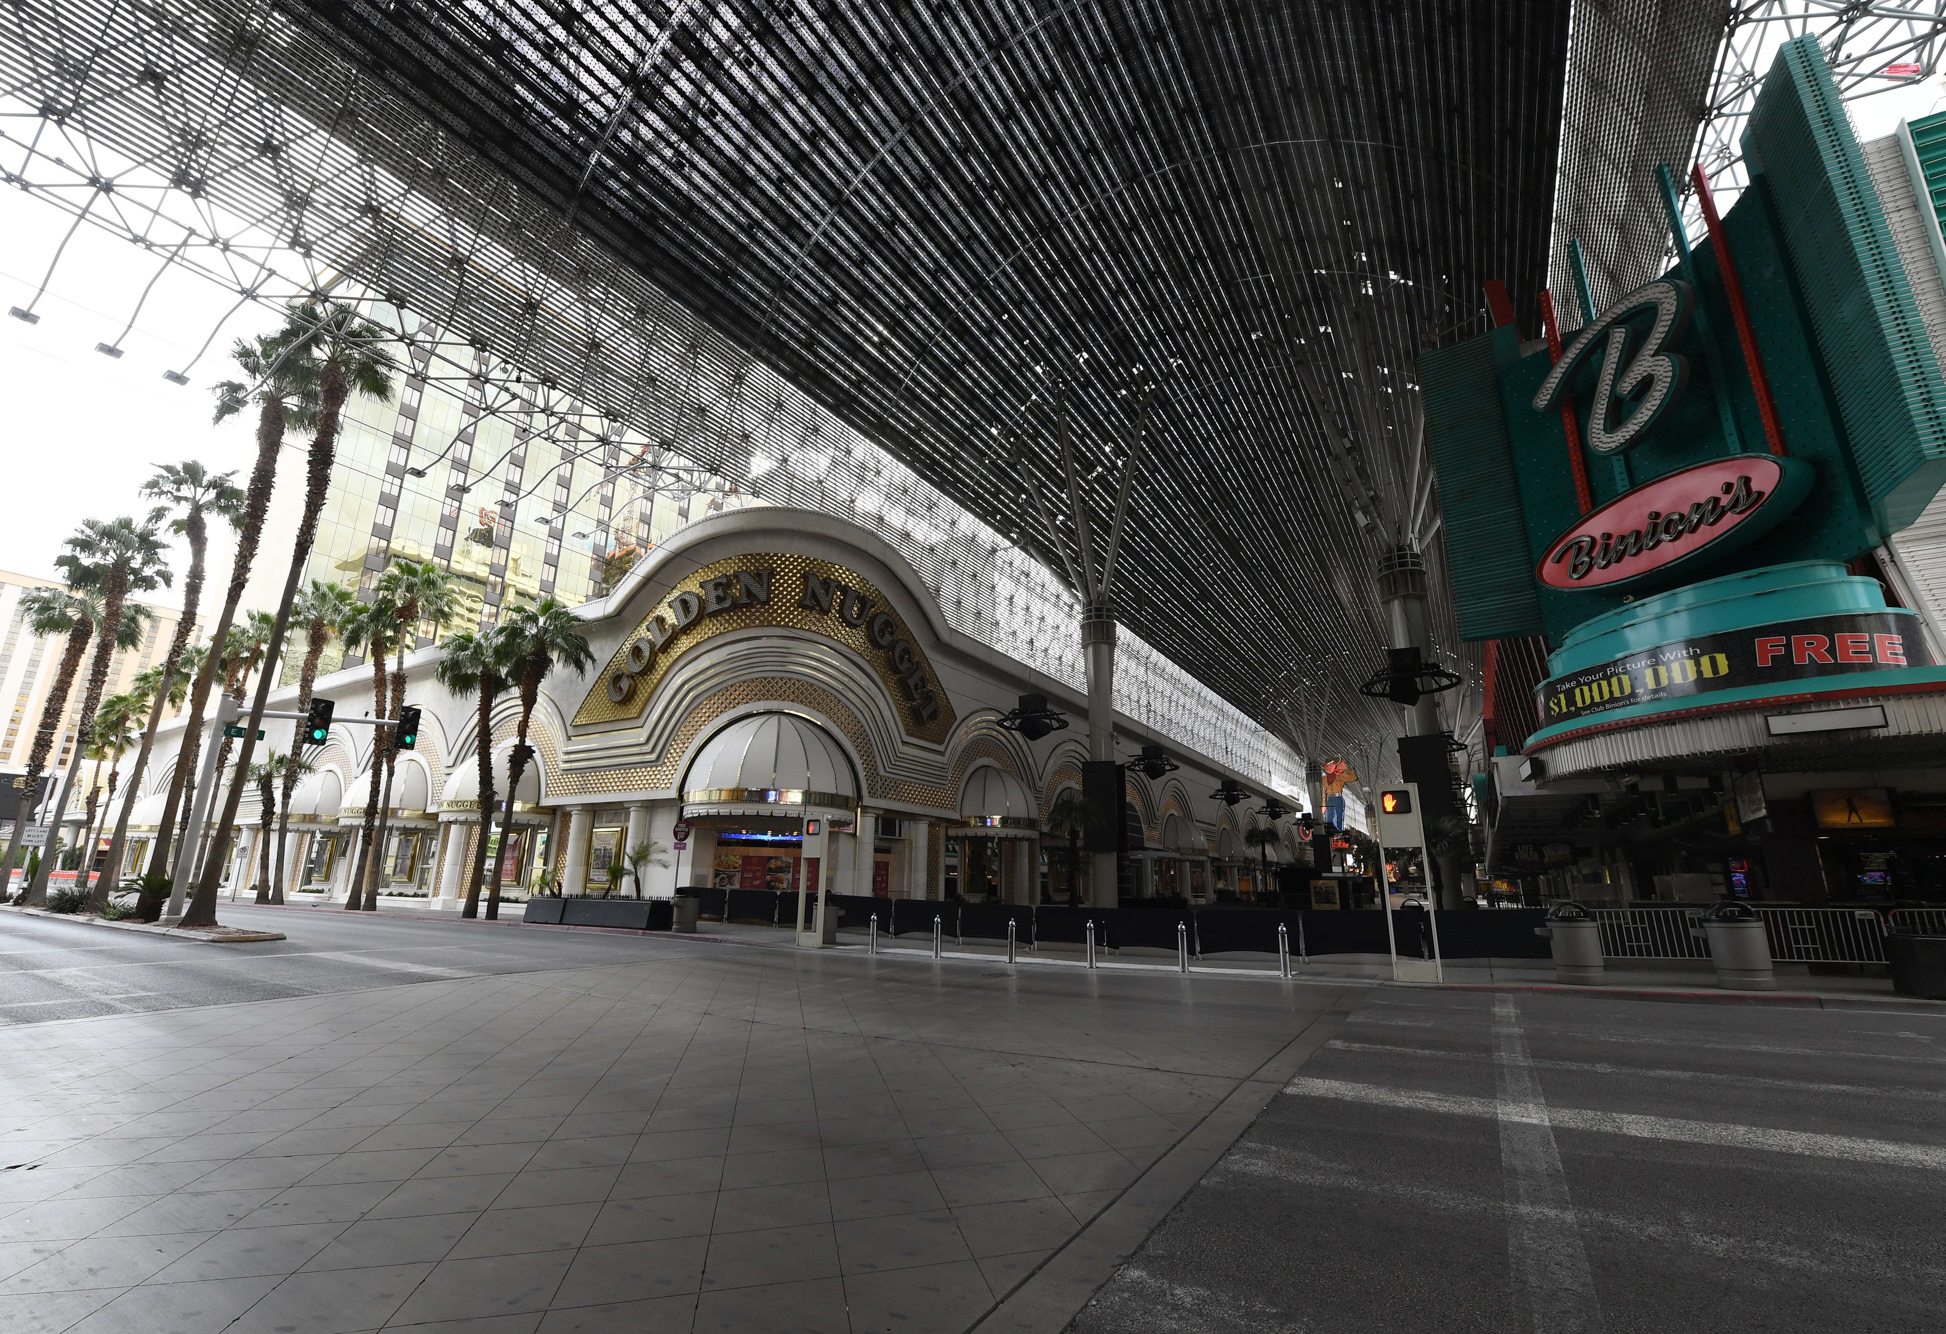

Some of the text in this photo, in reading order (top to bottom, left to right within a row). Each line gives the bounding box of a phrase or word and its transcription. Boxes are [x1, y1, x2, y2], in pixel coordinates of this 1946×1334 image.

[1533, 279, 1692, 454] B
[1551, 475, 1765, 580] Binion's
[607, 568, 940, 727] GOLDEN NUGGET
[1556, 646, 1700, 692] Take Your Picture With
[1755, 632, 1907, 667] FREE
[1591, 704, 1605, 714] Club
[1605, 699, 1630, 711] Binion's
[1630, 696, 1640, 704] for
[1641, 690, 1668, 702] details
